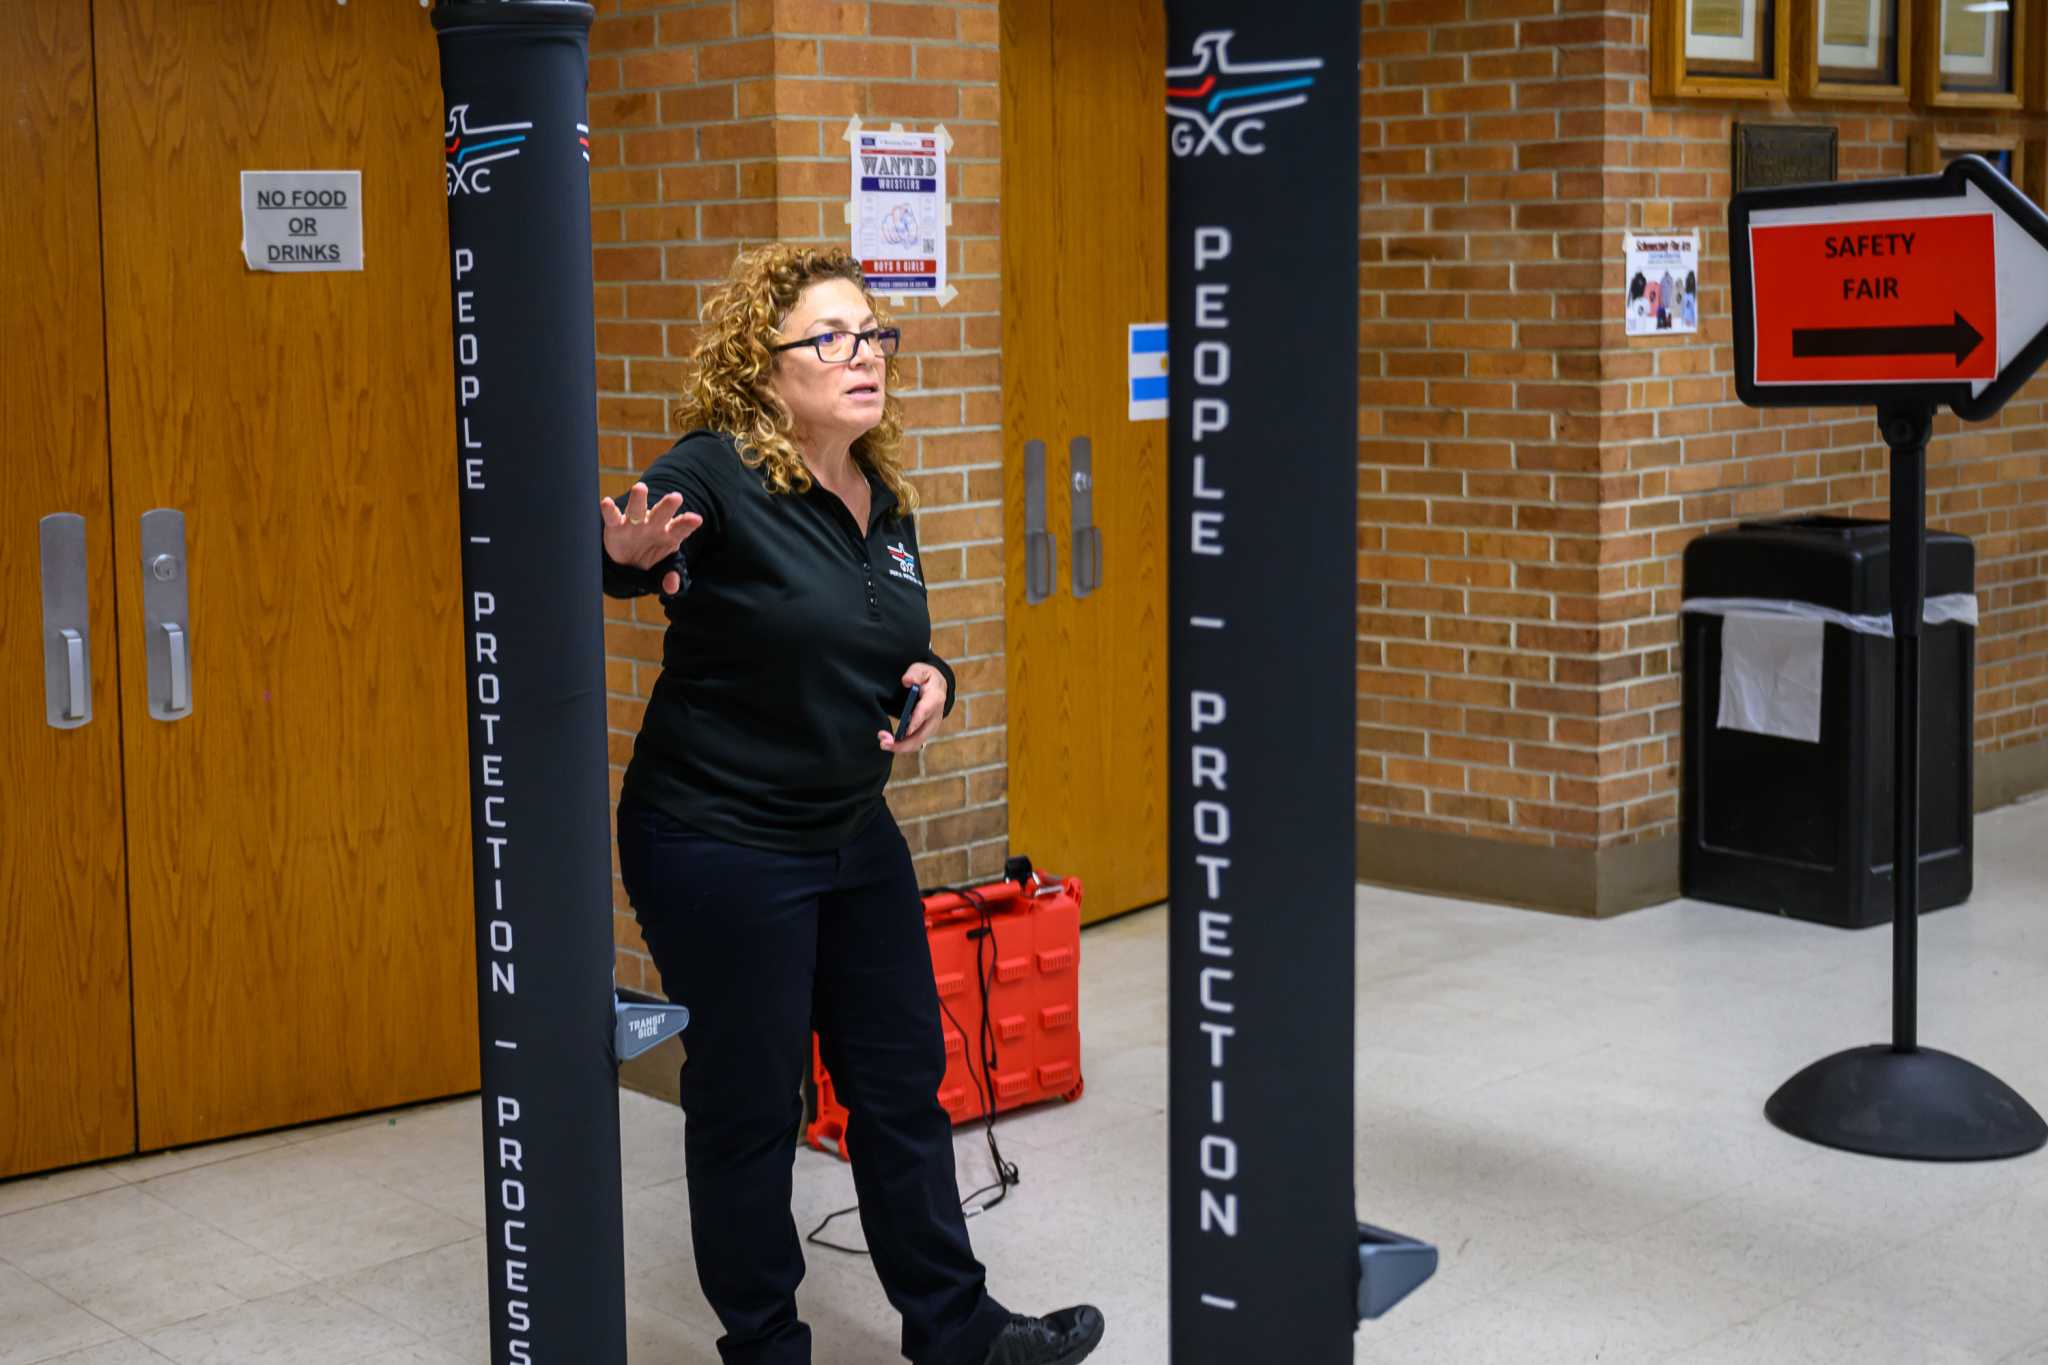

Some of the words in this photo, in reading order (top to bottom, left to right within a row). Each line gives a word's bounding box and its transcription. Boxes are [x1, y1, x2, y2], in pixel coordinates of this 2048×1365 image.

[1172, 120, 1265, 156] GXC
[861, 156, 936, 176] WANTED
[878, 178, 920, 191] WRESTLERS
[257, 190, 286, 207] NO
[292, 190, 347, 207] FOOD
[288, 217, 317, 234] OR
[267, 244, 340, 261] DRINKS
[1825, 232, 1917, 259] SAFETY
[1843, 277, 1899, 300] FAIR
[1191, 226, 1232, 556] PEOPLE
[455, 248, 485, 490] PEOPLE
[474, 592, 515, 995] PROTECTION
[497, 1095, 532, 1365] PROCESS
[1190, 690, 1238, 1237] PROTECTION
[628, 1012, 666, 1032] TRANSIT
[638, 1023, 659, 1040] SIDE
